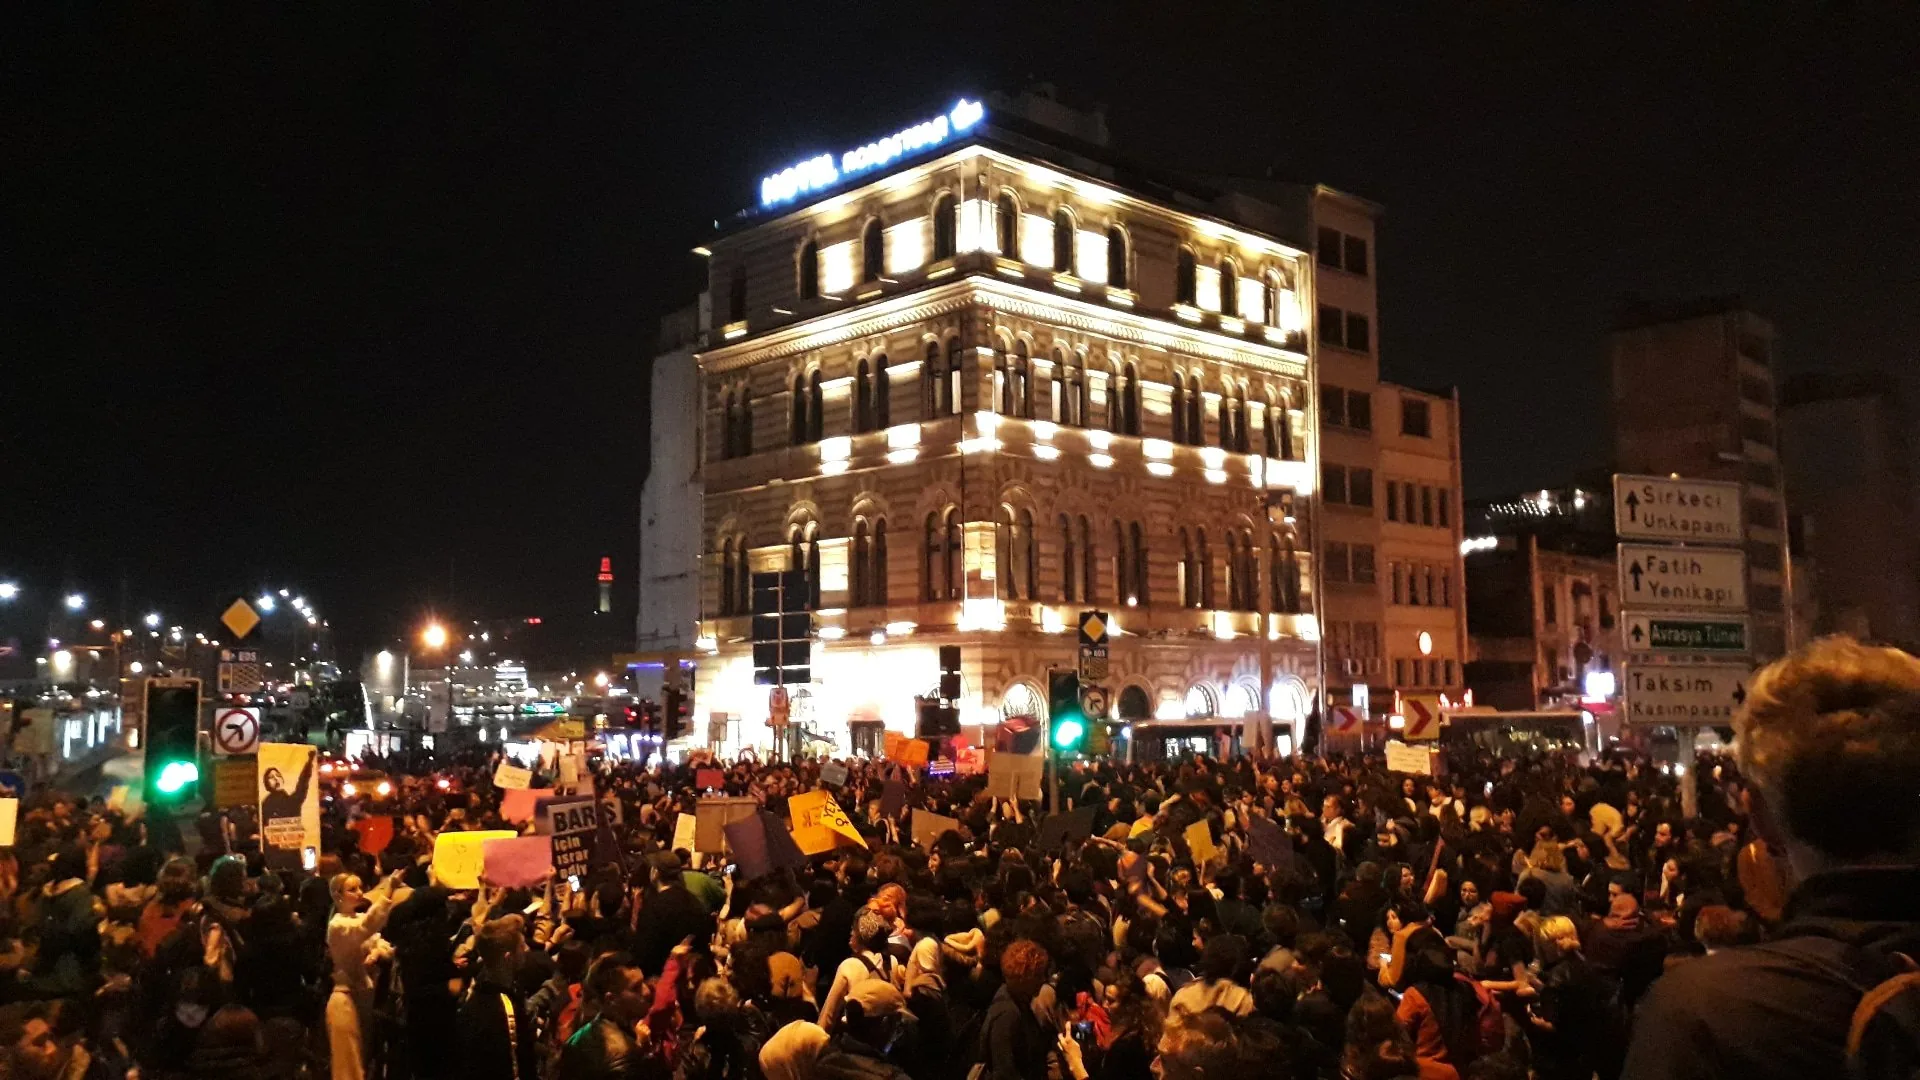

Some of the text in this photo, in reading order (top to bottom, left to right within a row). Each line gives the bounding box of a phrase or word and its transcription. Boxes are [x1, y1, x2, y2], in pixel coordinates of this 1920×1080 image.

[1643, 484, 1721, 508] Sirkeci
[1646, 555, 1702, 576] Fatih
[1633, 672, 1713, 693] Taksim
